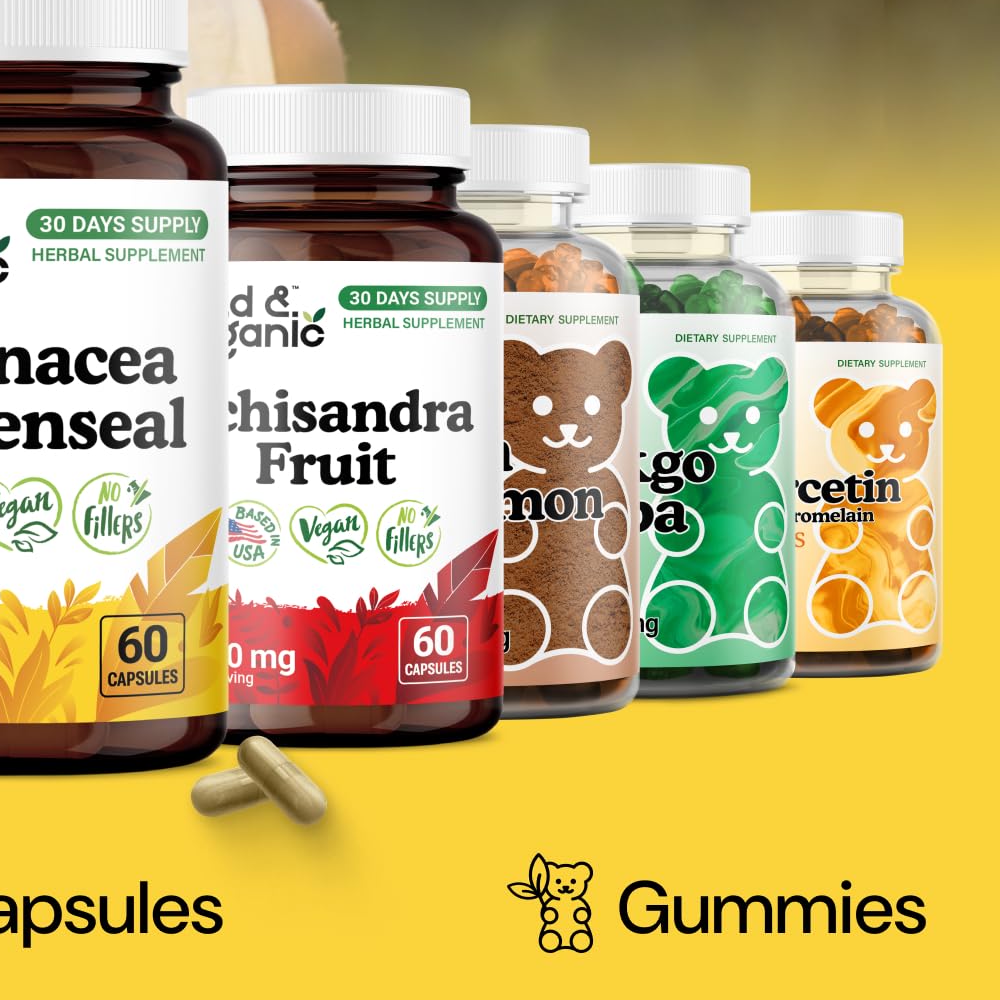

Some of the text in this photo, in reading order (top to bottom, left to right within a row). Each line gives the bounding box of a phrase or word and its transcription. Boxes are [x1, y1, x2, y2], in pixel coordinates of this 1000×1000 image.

[39, 215, 201, 233] 30 DAYS SUPPLY
[32, 247, 206, 262] HERBAL SUPPLEMENT
[349, 291, 481, 306] 30 DAYS SUPPLY
[343, 317, 486, 329] HERBAL SUPPLEMENT
[505, 314, 619, 325] DIETARY SUPPLEMENT
[675, 334, 777, 344] DIETARY SUPPLEMENT
[837, 359, 927, 368] DIETARY SUPPLEMENT
[255, 441, 397, 486] Fruit
[98, 480, 121, 504] NO
[397, 506, 415, 526] NO
[235, 506, 280, 547] BASED IN
[299, 515, 360, 546] Vegan
[233, 544, 265, 562] USA
[118, 624, 168, 664] 60
[413, 624, 454, 658] 60
[250, 649, 296, 677] mg
[405, 660, 463, 677] CAPSULES
[107, 669, 178, 687] CAPSULES
